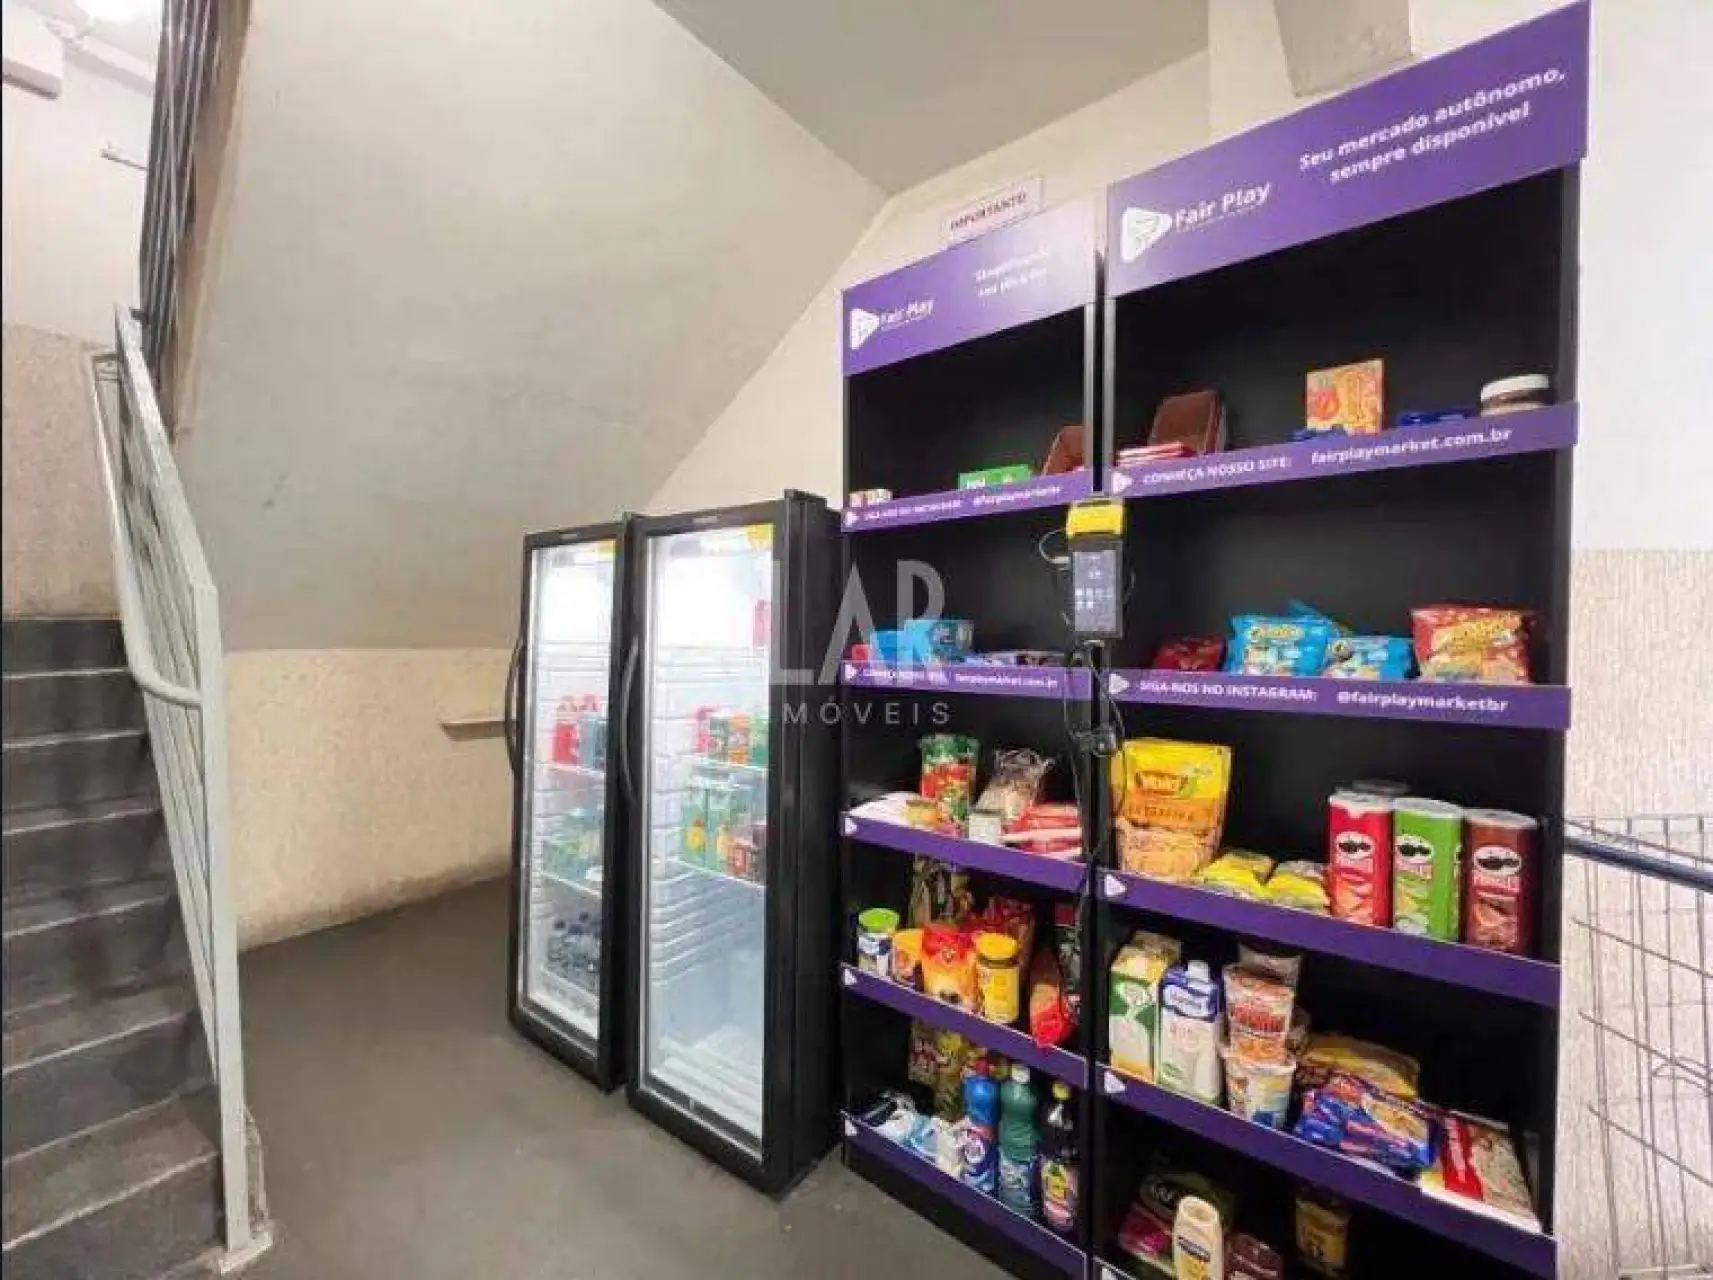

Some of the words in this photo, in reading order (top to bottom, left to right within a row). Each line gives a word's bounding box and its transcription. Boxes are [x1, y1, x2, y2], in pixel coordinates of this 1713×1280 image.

[1300, 149, 1333, 170] Seu
[1338, 114, 1430, 155] mercado
[1435, 68, 1565, 122] autônomo,
[1329, 147, 1407, 183] sempre
[1412, 101, 1530, 155] disponível
[1175, 200, 1216, 232] Fair
[1222, 181, 1270, 212] Play
[1207, 460, 1255, 477] NOSSO
[1311, 427, 1513, 465] fairplaymarket.com.br
